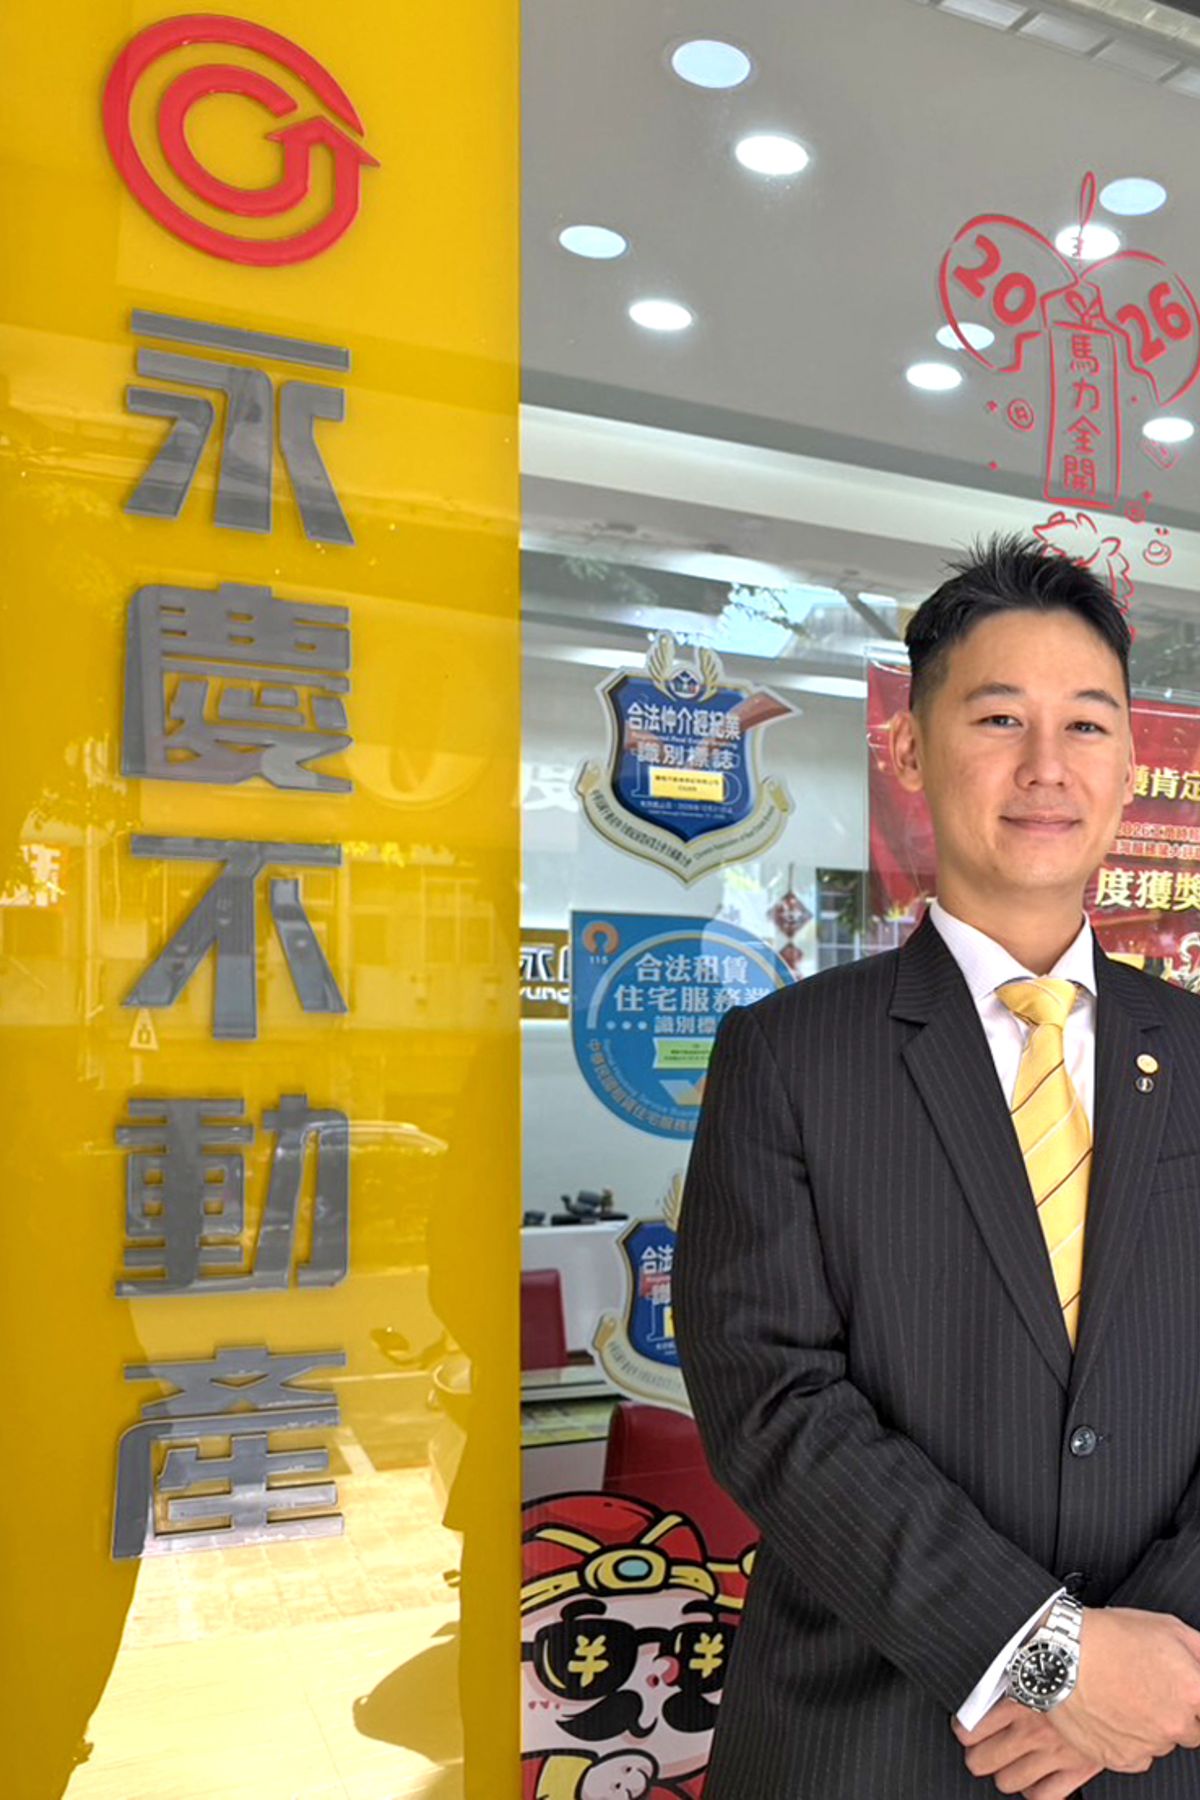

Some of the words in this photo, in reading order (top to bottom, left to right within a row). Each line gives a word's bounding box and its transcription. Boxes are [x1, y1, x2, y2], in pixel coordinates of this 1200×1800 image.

[953, 234, 1037, 325] 20
[1116, 282, 1193, 364] 26
[1063, 332, 1101, 498] 馬力全開
[628, 701, 741, 740] 合法仲介經紀業
[111, 307, 355, 1561] 永慶不動產
[519, 943, 571, 983] 永
[635, 952, 748, 985] 合法租賃
